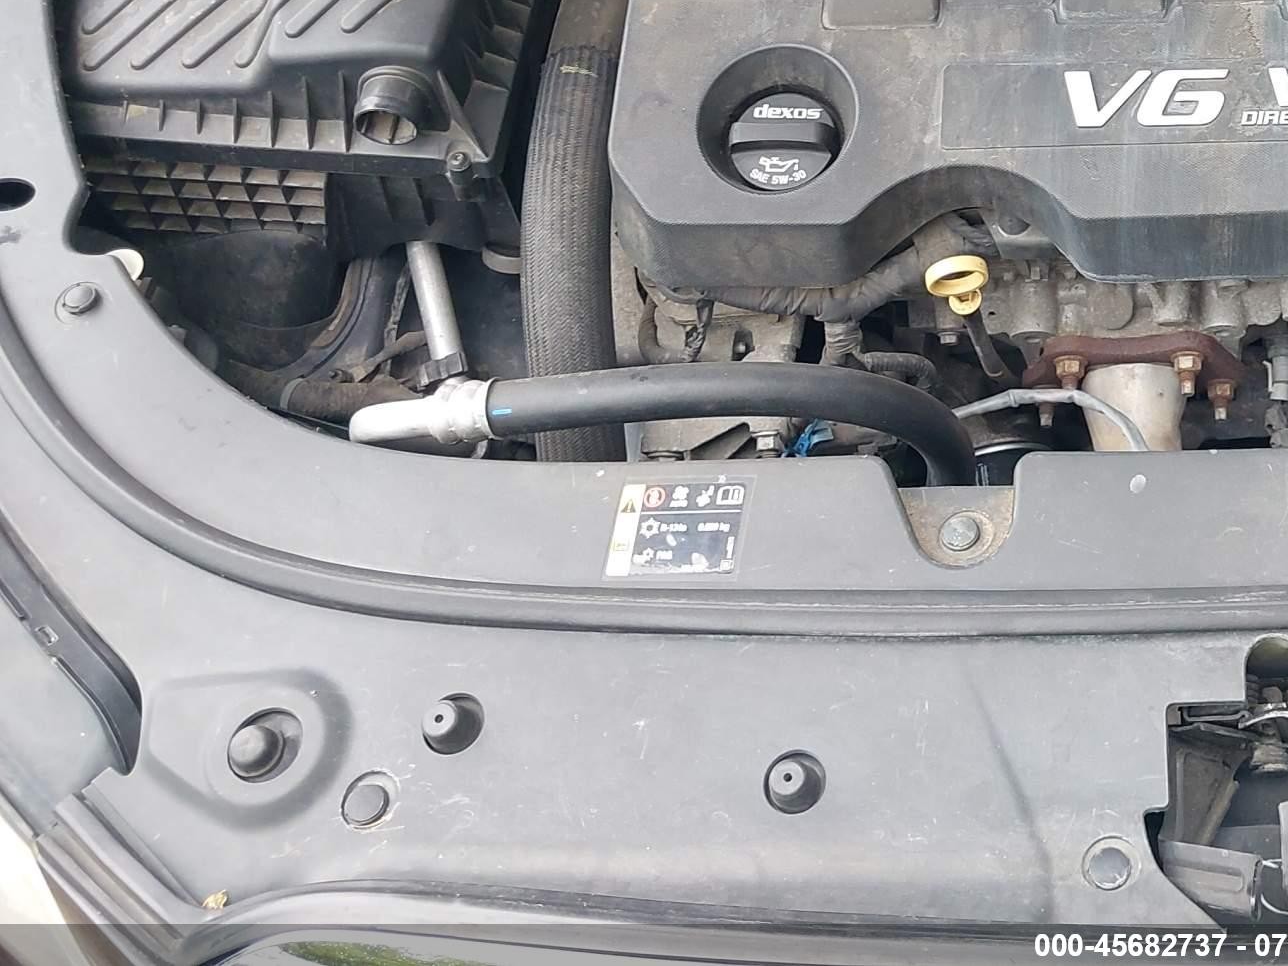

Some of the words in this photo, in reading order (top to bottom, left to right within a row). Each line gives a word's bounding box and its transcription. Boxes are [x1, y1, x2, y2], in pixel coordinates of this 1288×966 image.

[1064, 69, 1229, 128] V6
[753, 103, 824, 119] dexos
[749, 168, 771, 184] SAE
[771, 169, 807, 185] 5W-30
